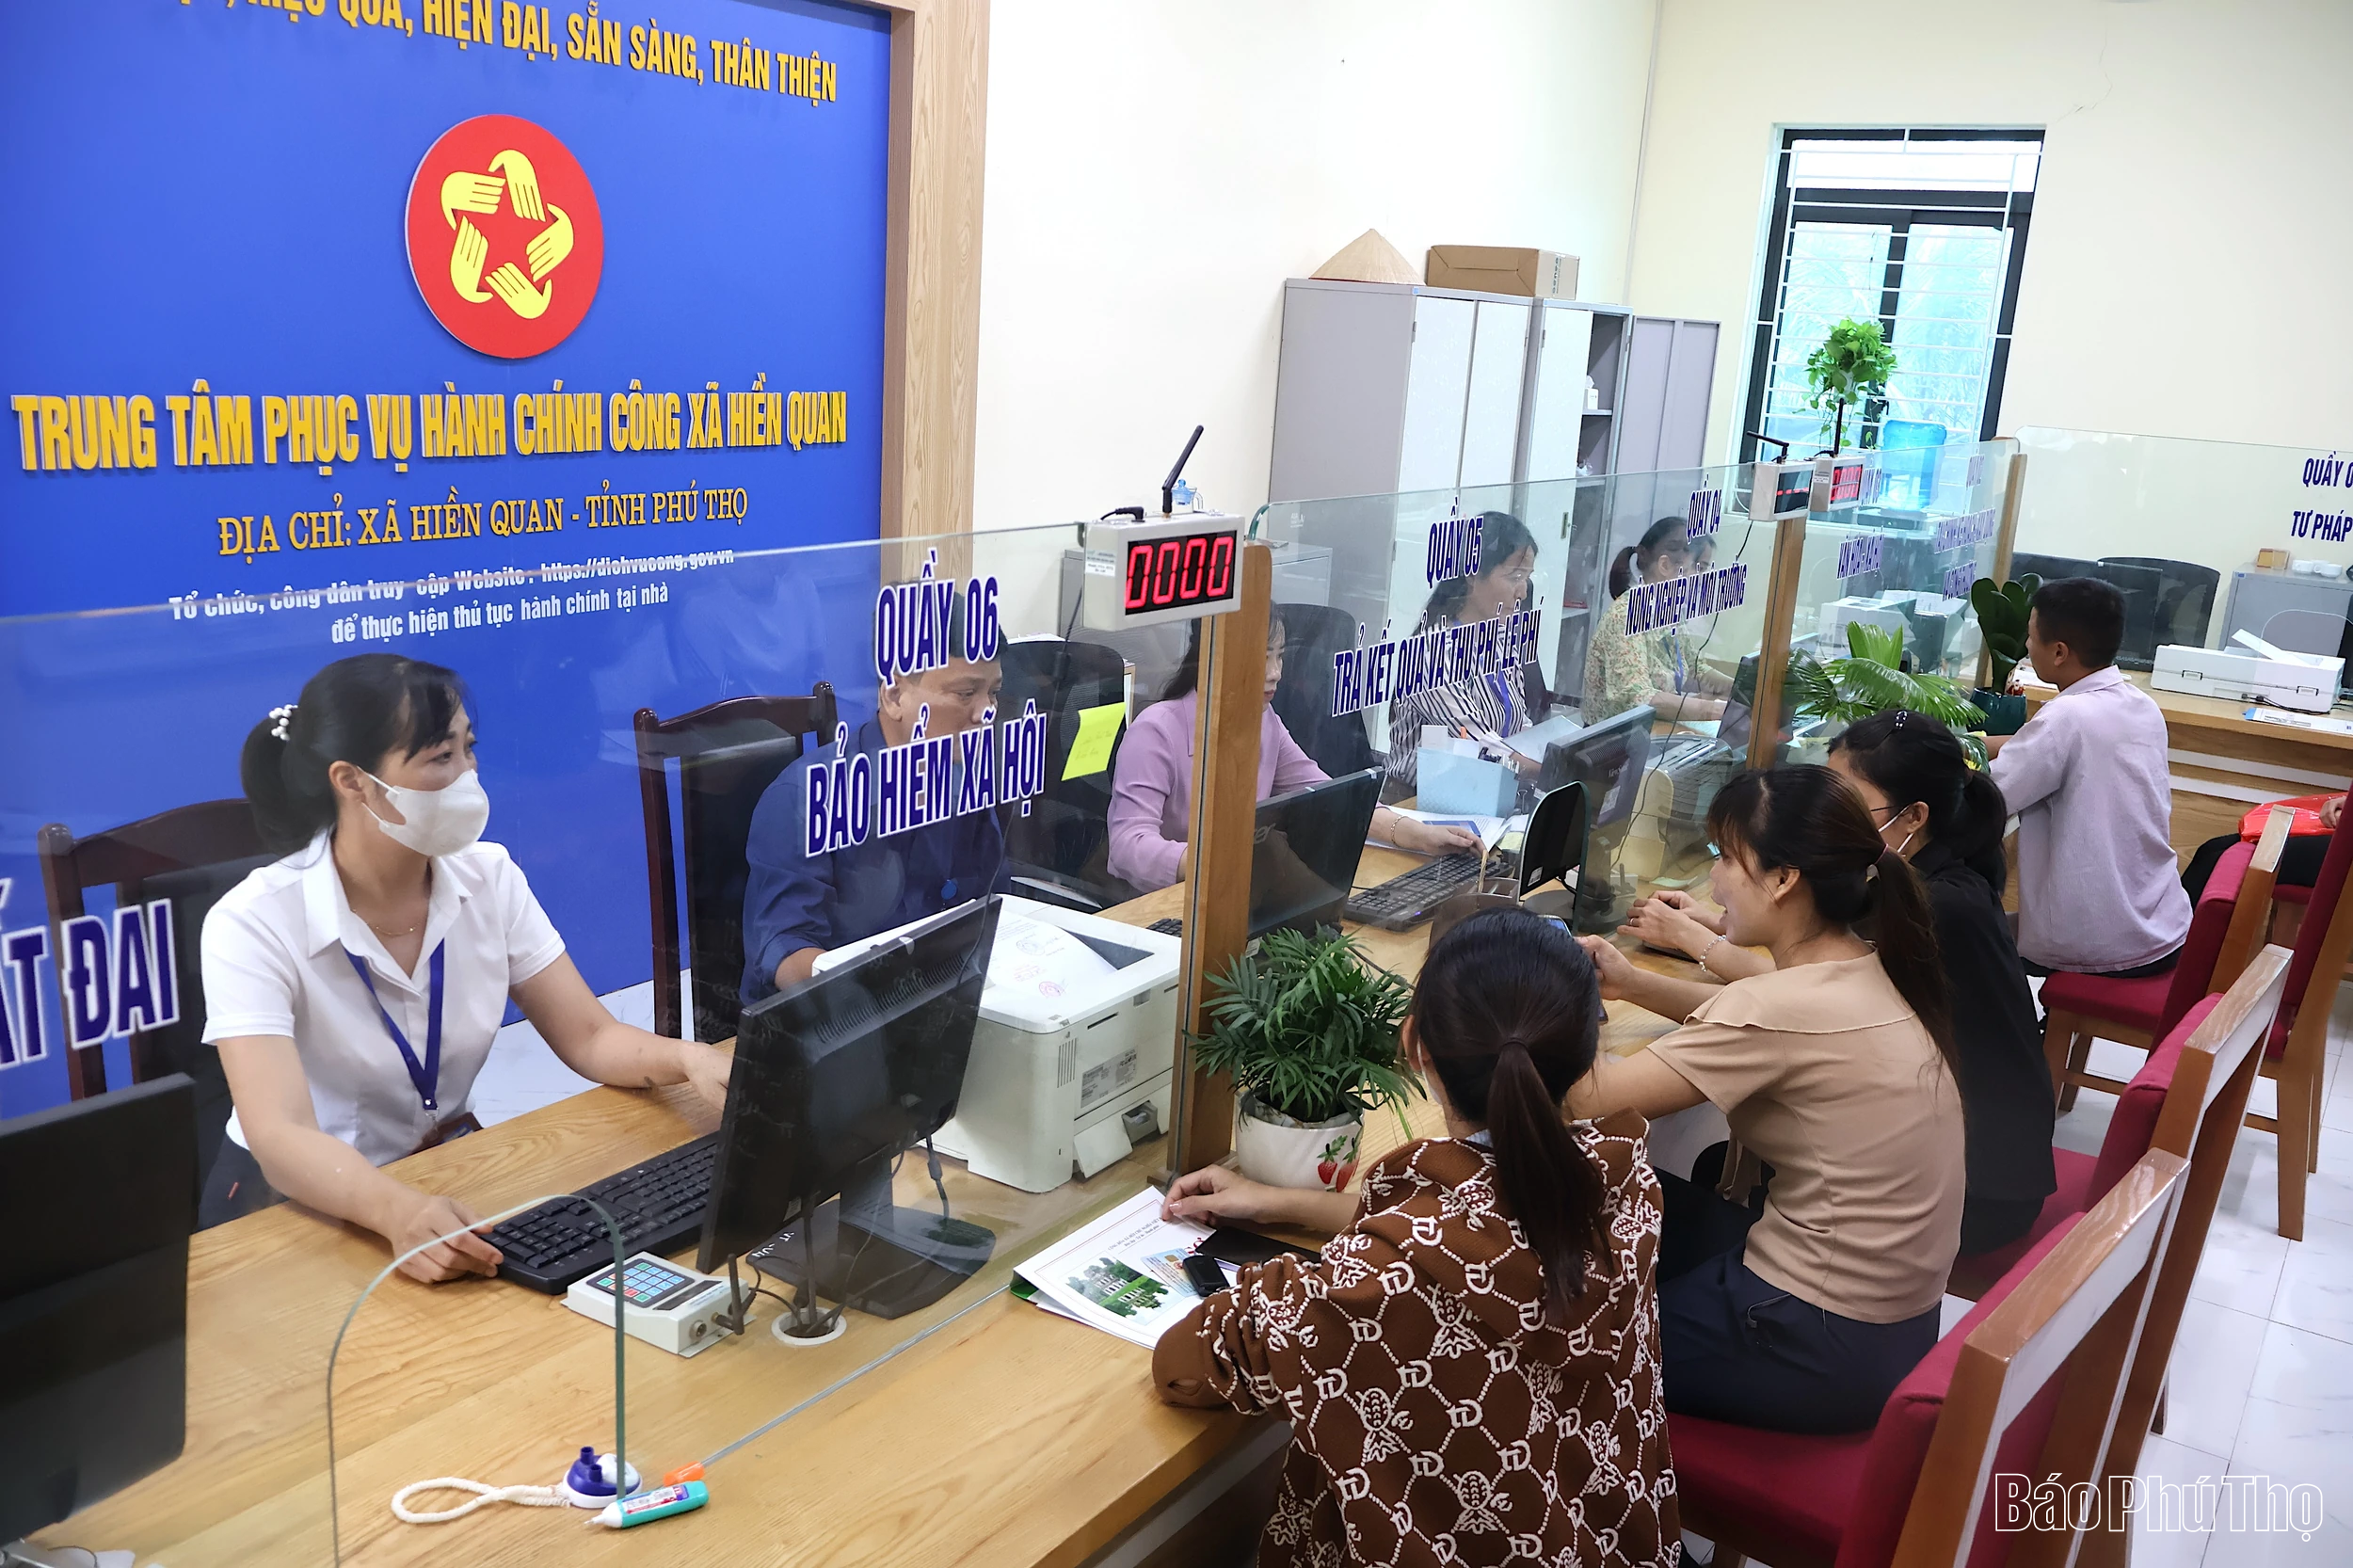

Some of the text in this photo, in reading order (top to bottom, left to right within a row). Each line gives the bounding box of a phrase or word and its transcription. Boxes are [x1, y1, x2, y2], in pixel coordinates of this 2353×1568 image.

[424, 0, 492, 49] HIỆN
[502, 1, 558, 61] ĐẠI,
[567, 0, 621, 66] SẴN
[630, 18, 703, 86] SÀNG,
[711, 38, 770, 90] THÂN
[776, 51, 836, 106] THIỆN
[11, 372, 847, 476] TRUNG TÂM PHỤC VỤ HÀNH CHÍNH CÔNG XÃ HIỀN QUAN
[1687, 472, 1722, 546] QUẦY 04
[2302, 451, 2345, 488] QUẦY
[217, 479, 749, 565] ĐỊA CHỈ: XÃ HIỀN QUAN - TỈNH PHÚ THỌ
[1426, 495, 1483, 590] QUẦY 05
[2291, 509, 2353, 543] TƯ PHÁP
[168, 589, 200, 620] Tổ
[269, 584, 321, 610] công
[327, 580, 363, 605] dân
[367, 579, 405, 600] truy
[416, 572, 450, 600] cập
[331, 581, 669, 644] để thực hiện thủ tục hành chính tại nhà
[1125, 536, 1234, 609] 0000
[1625, 554, 1748, 638] NÔNG NGHIỆP VÀ MÔI TRƯỜNG
[875, 547, 999, 688] QUẦY 06
[1332, 596, 1545, 718] TRẢ KẾT QUẢ VÀ THU PHÍ, LỆ PHÍ
[806, 697, 1048, 858] BẢO HIỂM XÃ HỘI
[60, 897, 180, 1051] ĐAI
